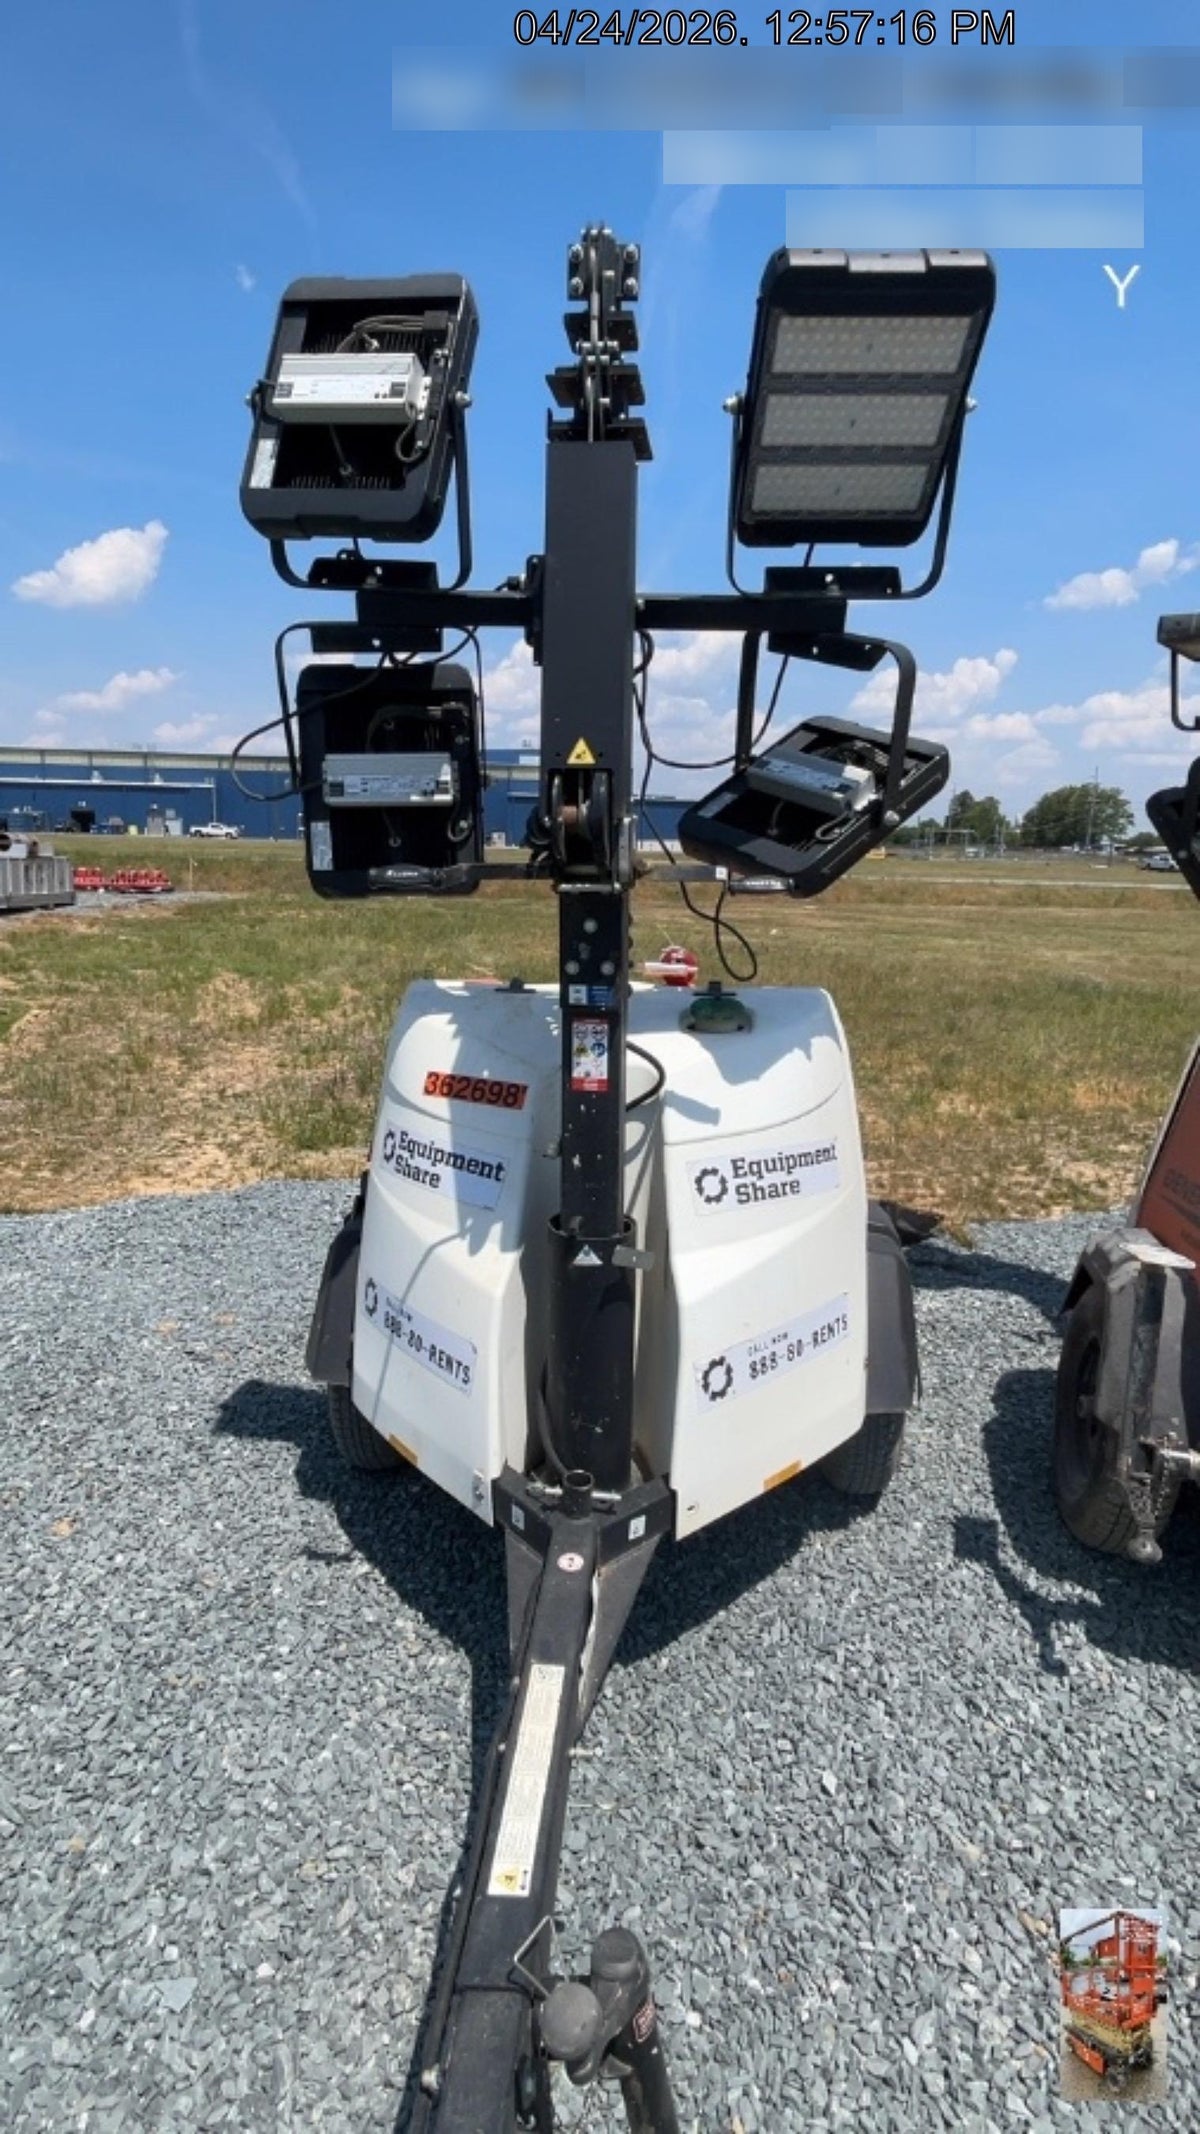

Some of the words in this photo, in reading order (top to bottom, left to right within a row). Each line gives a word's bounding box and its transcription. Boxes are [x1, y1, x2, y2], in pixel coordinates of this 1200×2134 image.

[394, 1154, 441, 1188] Share
[398, 1130, 505, 1182] Equipment
[730, 1144, 838, 1179] Equipment
[734, 1179, 801, 1205] Share
[748, 1313, 848, 1380] 888-80-RENTS
